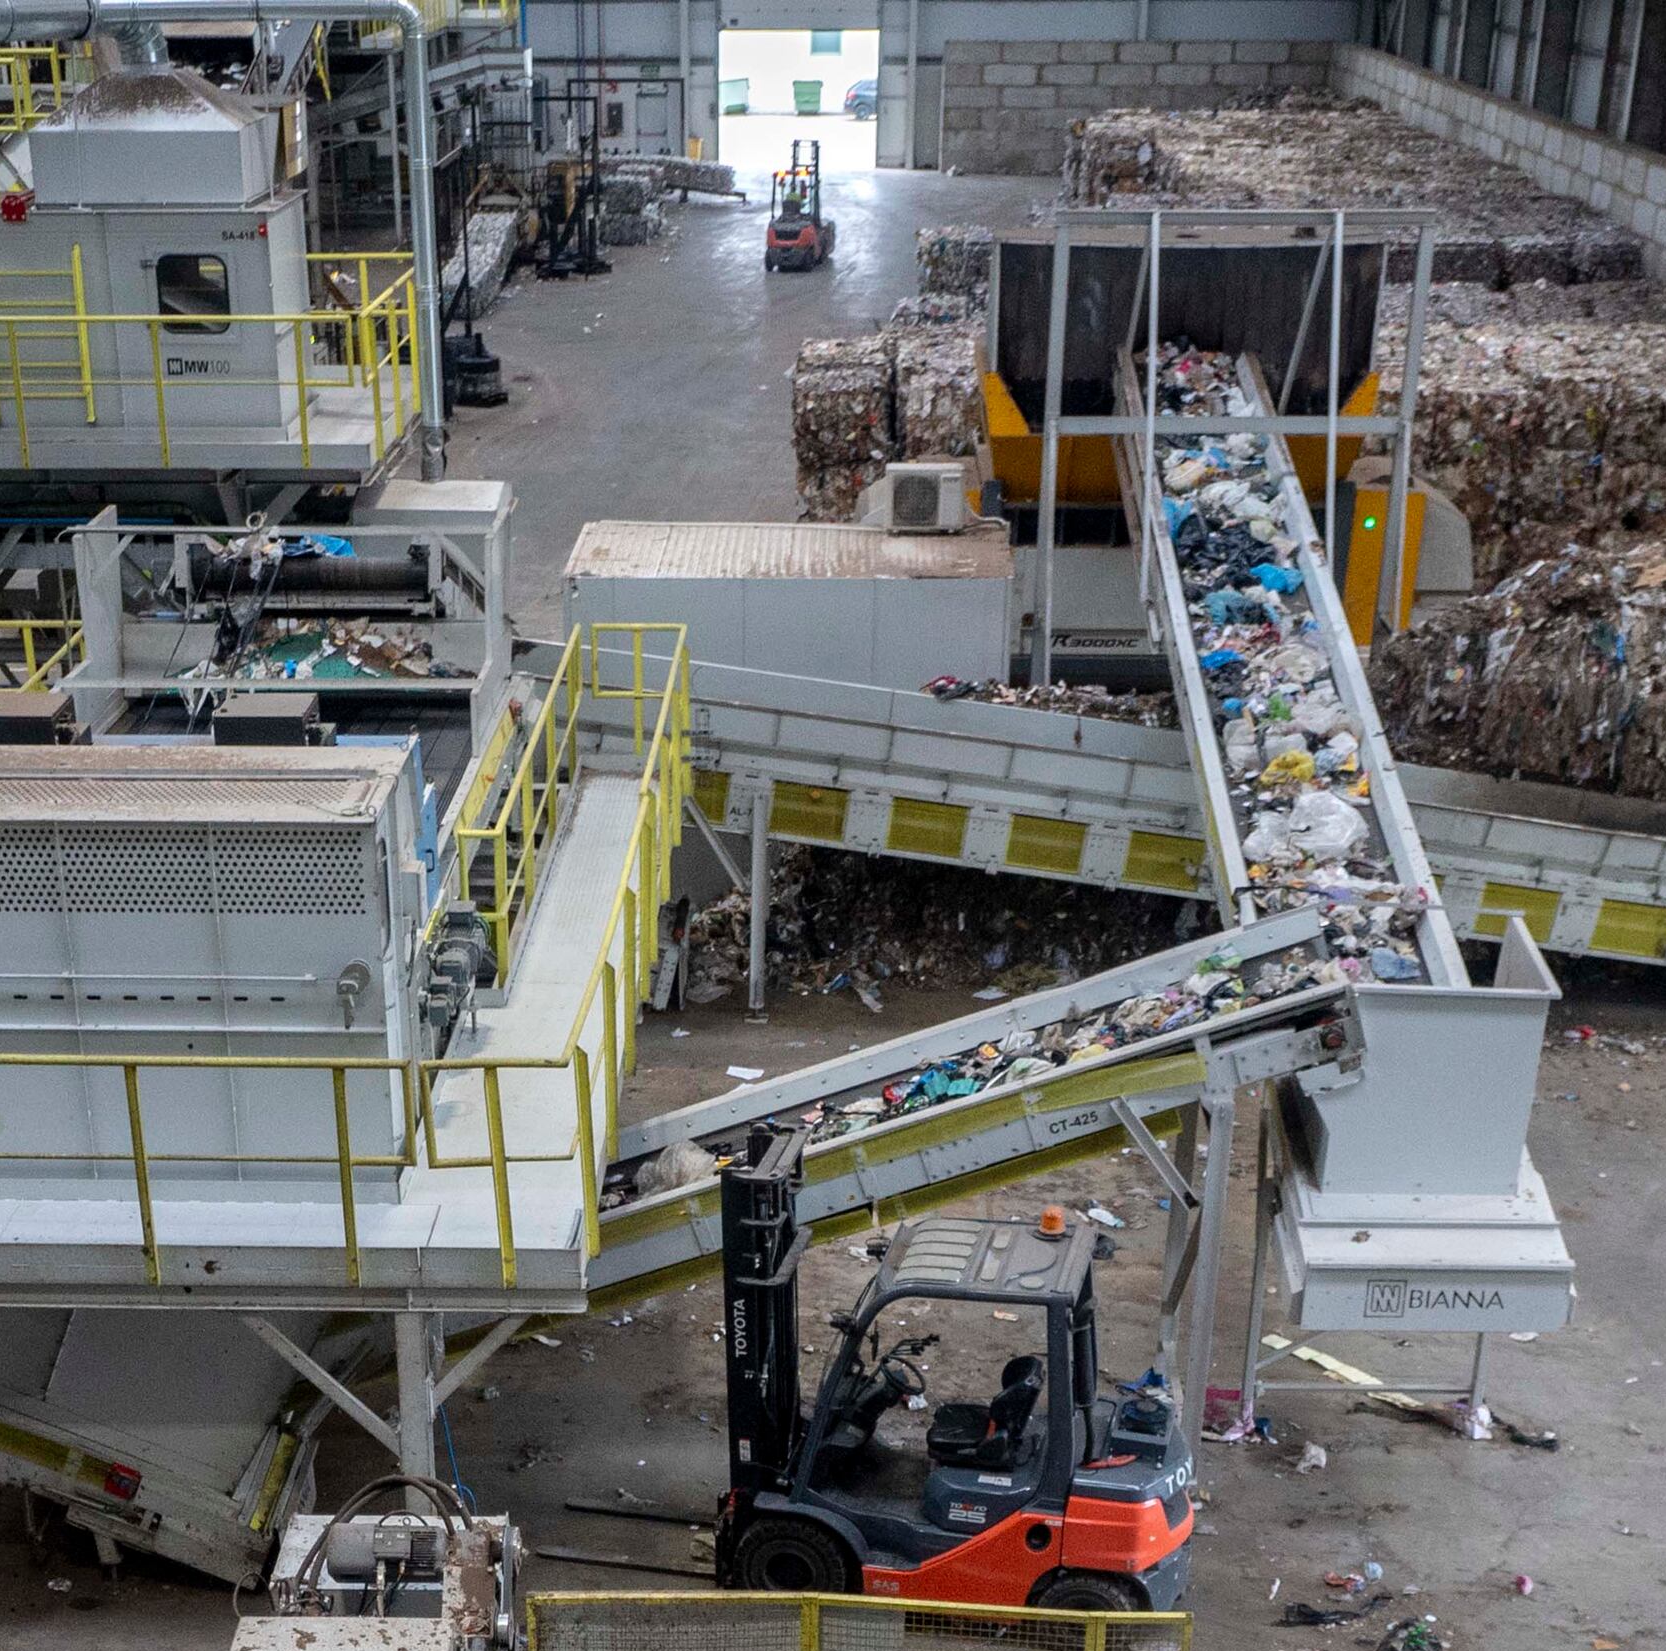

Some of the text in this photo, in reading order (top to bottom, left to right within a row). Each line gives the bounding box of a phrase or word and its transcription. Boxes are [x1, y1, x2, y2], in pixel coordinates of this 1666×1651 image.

[729, 807, 753, 817] AL-7
[1049, 1110, 1098, 1135] CT-425
[1409, 1289, 1504, 1310] BIANNA
[733, 1299, 748, 1358] TOYOTA
[1165, 1456, 1193, 1494] TOY
[948, 1508, 986, 1524] 25
